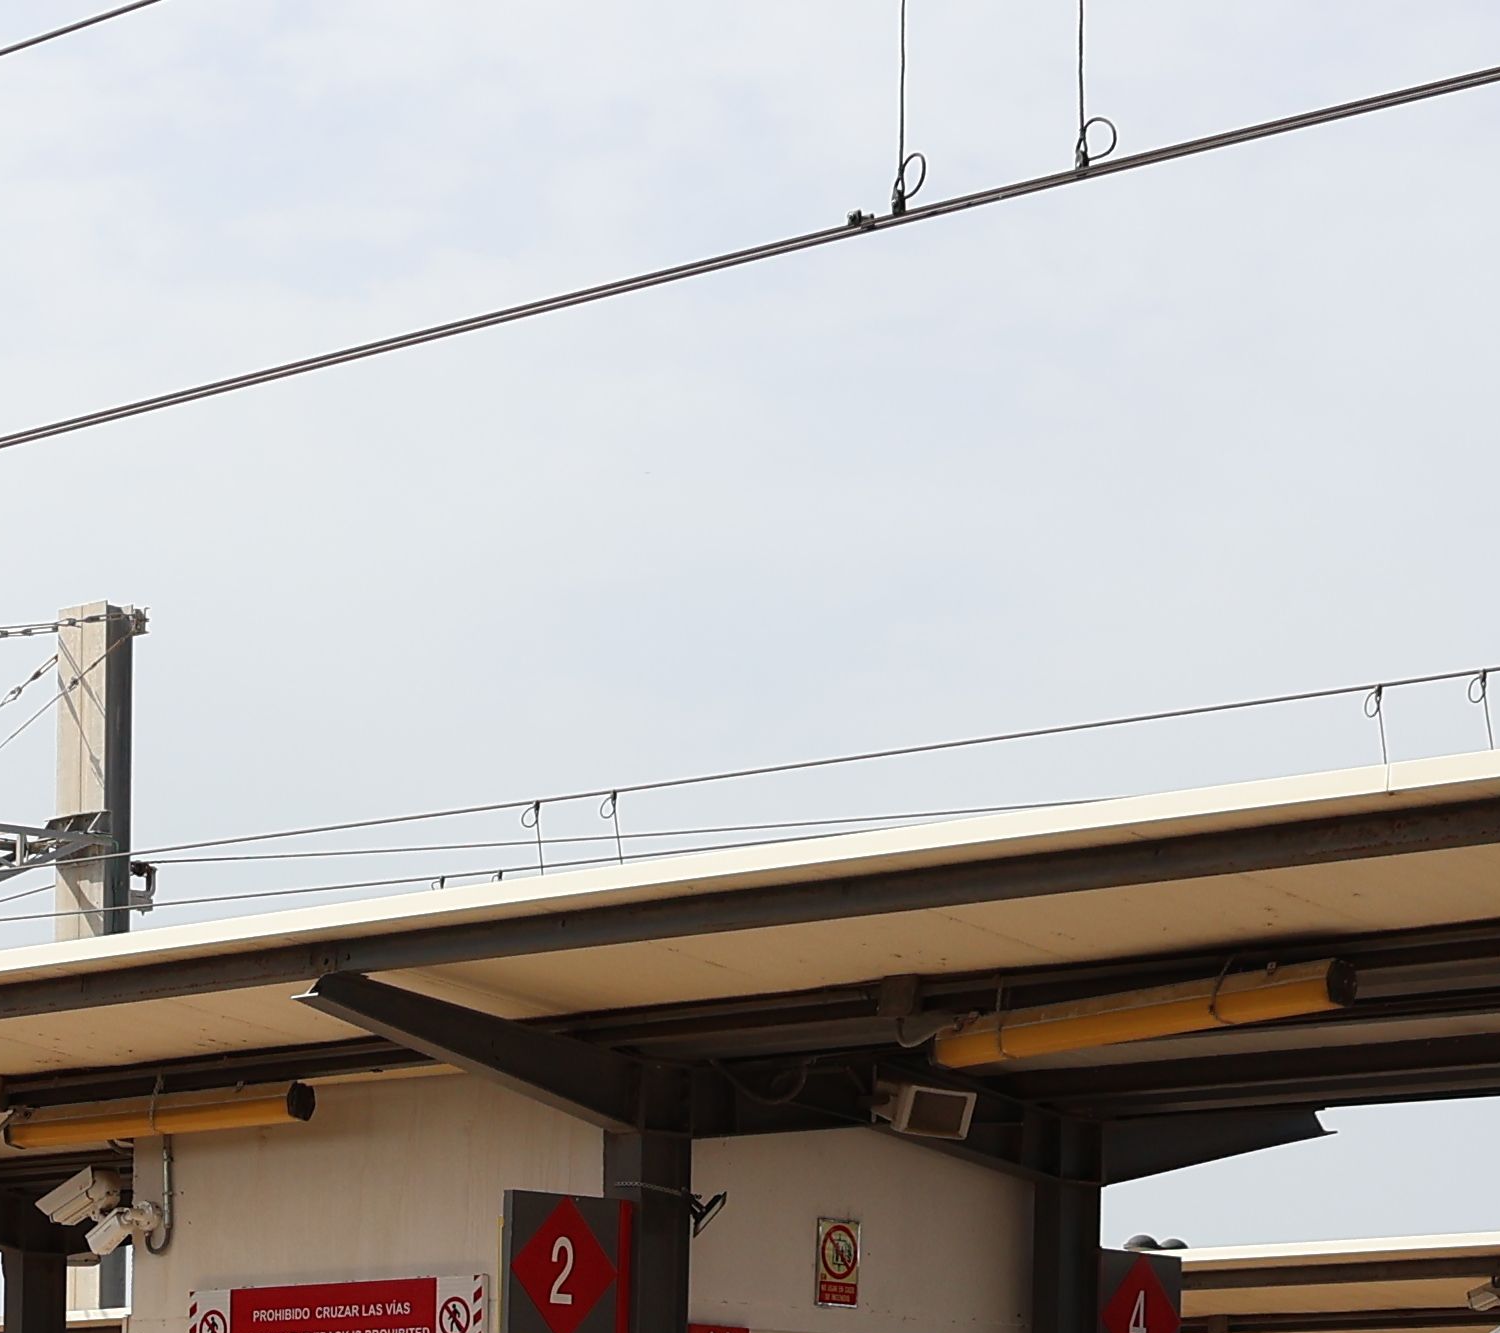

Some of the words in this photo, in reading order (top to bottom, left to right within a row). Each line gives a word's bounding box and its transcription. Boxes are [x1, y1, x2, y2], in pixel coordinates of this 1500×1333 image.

[550, 1236, 574, 1305] 2
[252, 1307, 310, 1323] PROHIBIDO
[315, 1305, 359, 1320] CRUZAR
[362, 1303, 383, 1317] LAS
[385, 1299, 411, 1315] VÍAS
